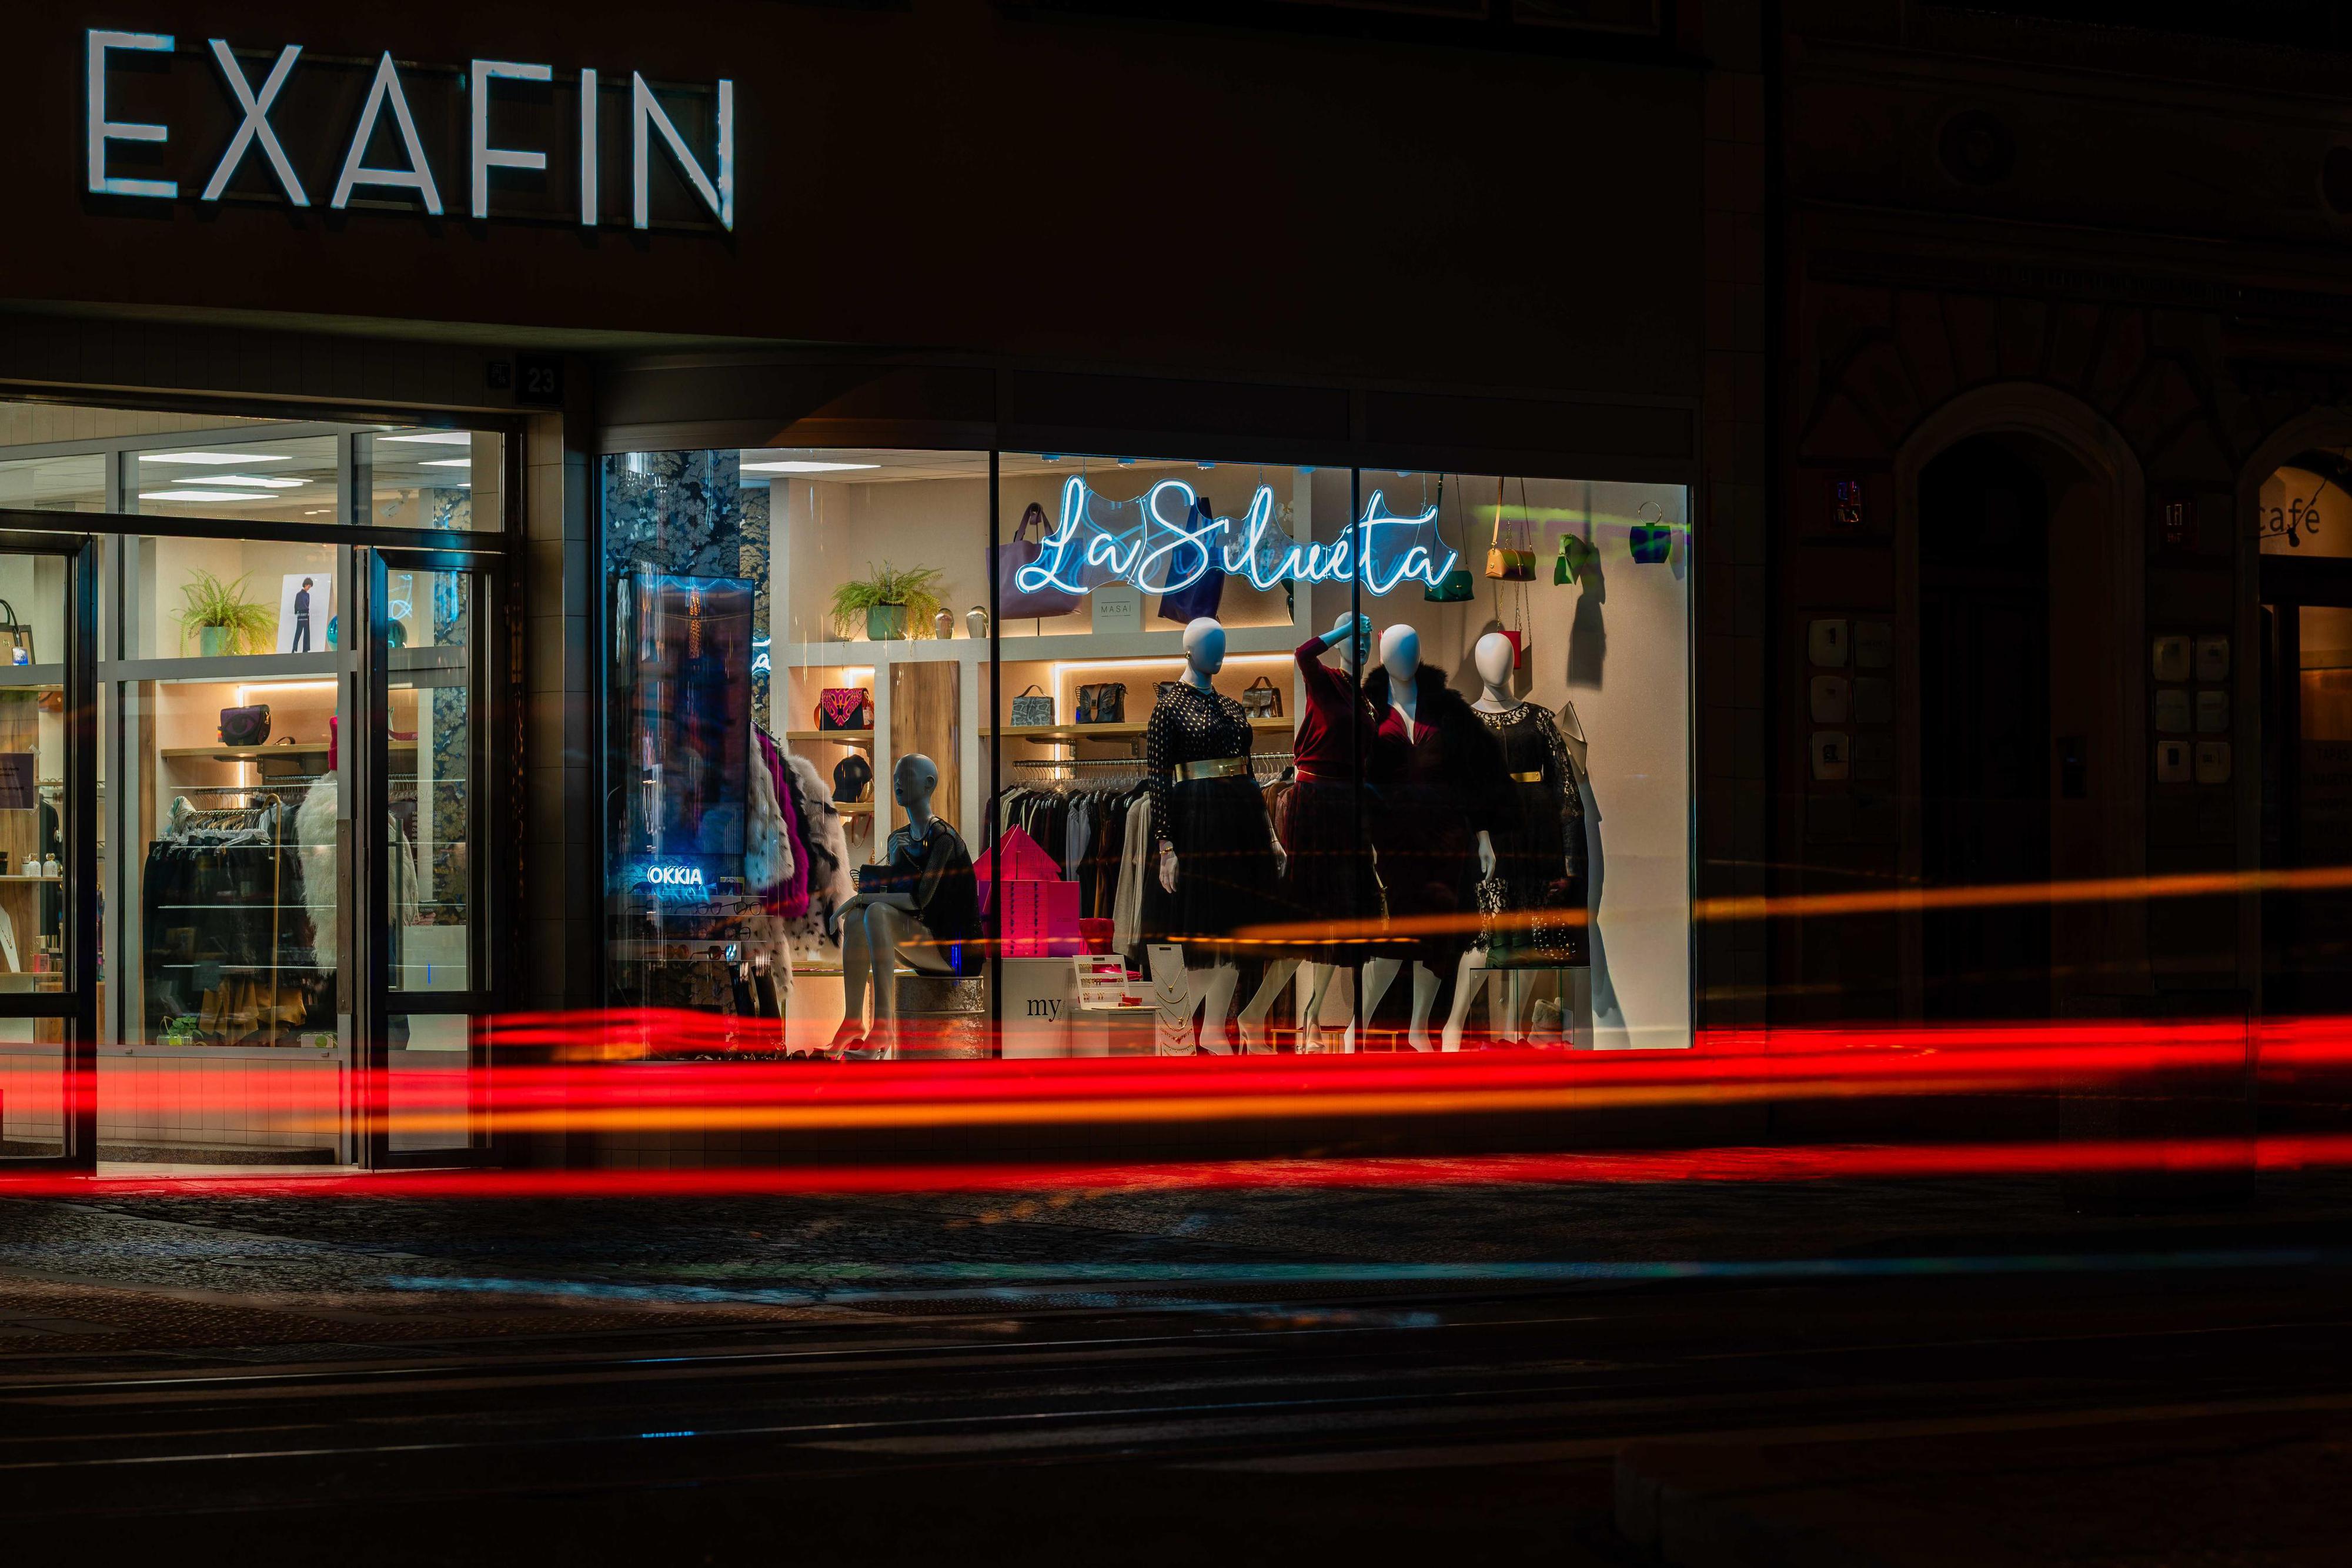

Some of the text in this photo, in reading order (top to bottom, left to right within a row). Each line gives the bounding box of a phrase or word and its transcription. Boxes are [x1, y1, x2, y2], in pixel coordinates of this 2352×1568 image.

[88, 28, 734, 232] EXAFIN
[527, 367, 555, 393] 23
[1016, 477, 1458, 594] La Silueta
[1101, 604, 1131, 613] MASAI
[649, 867, 703, 885] OKKIA
[1027, 999, 1062, 1022] my
